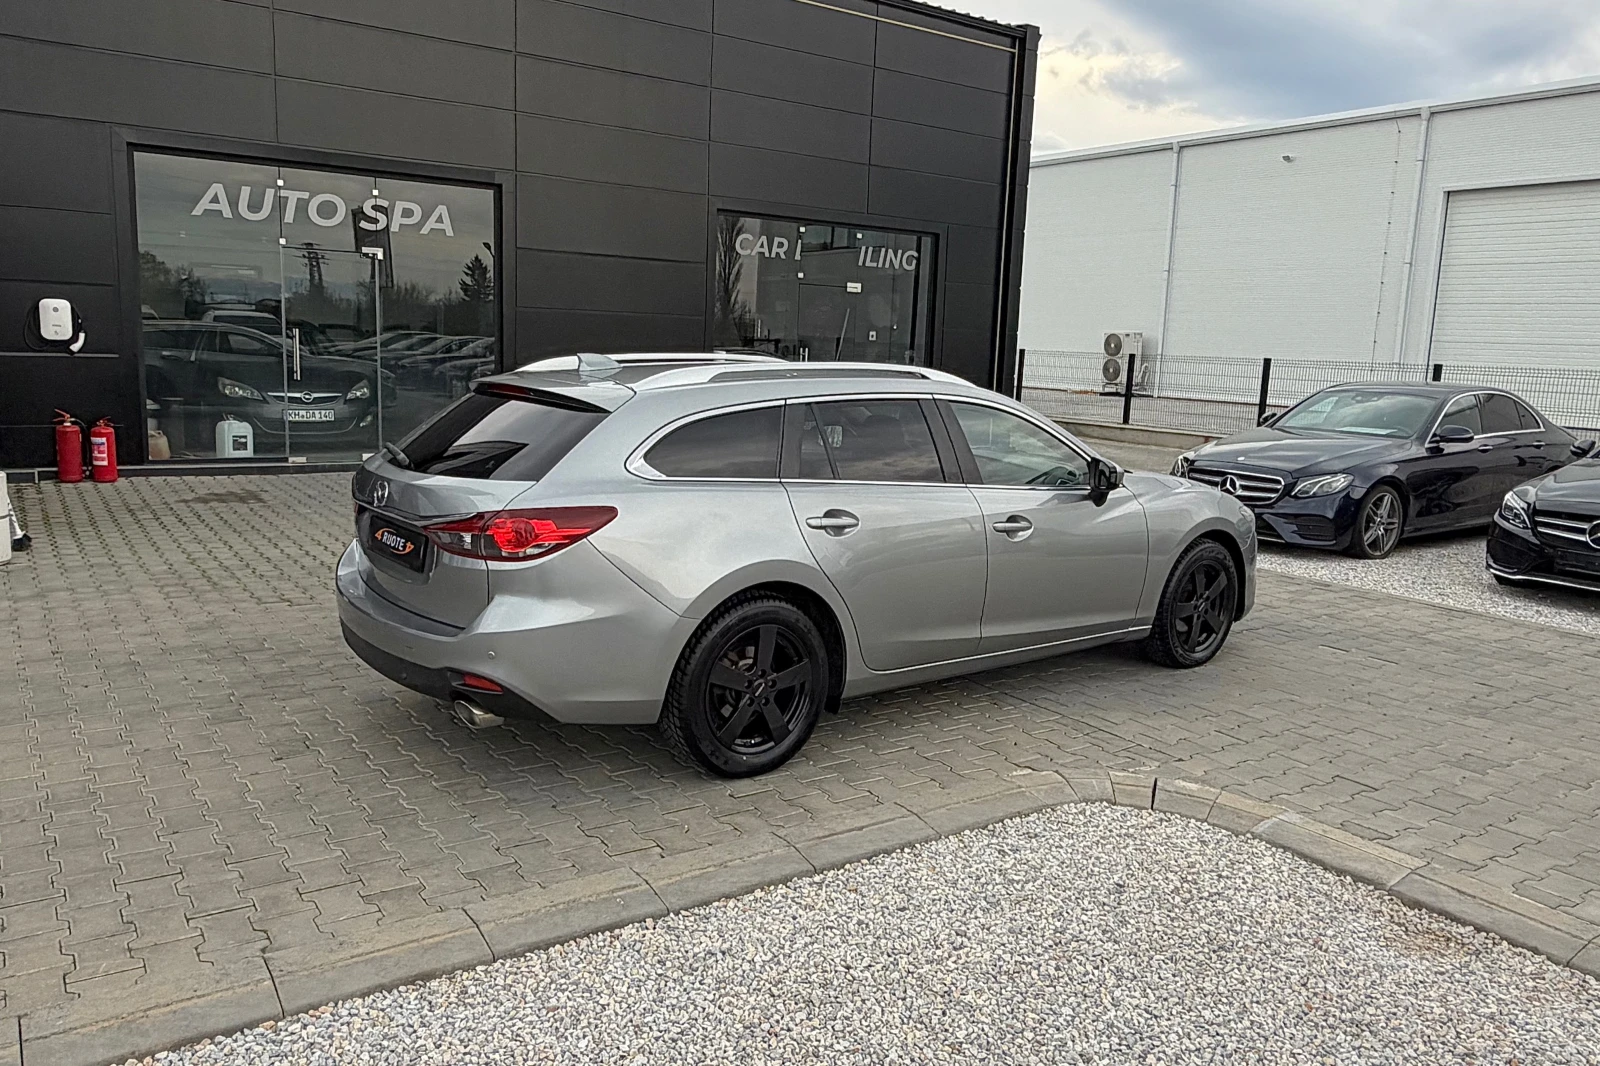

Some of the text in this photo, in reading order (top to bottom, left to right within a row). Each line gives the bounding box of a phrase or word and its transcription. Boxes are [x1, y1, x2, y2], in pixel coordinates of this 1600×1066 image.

[190, 182, 455, 237] AUTO SPA
[735, 233, 789, 260] CAR
[382, 531, 406, 551] RUOTE
